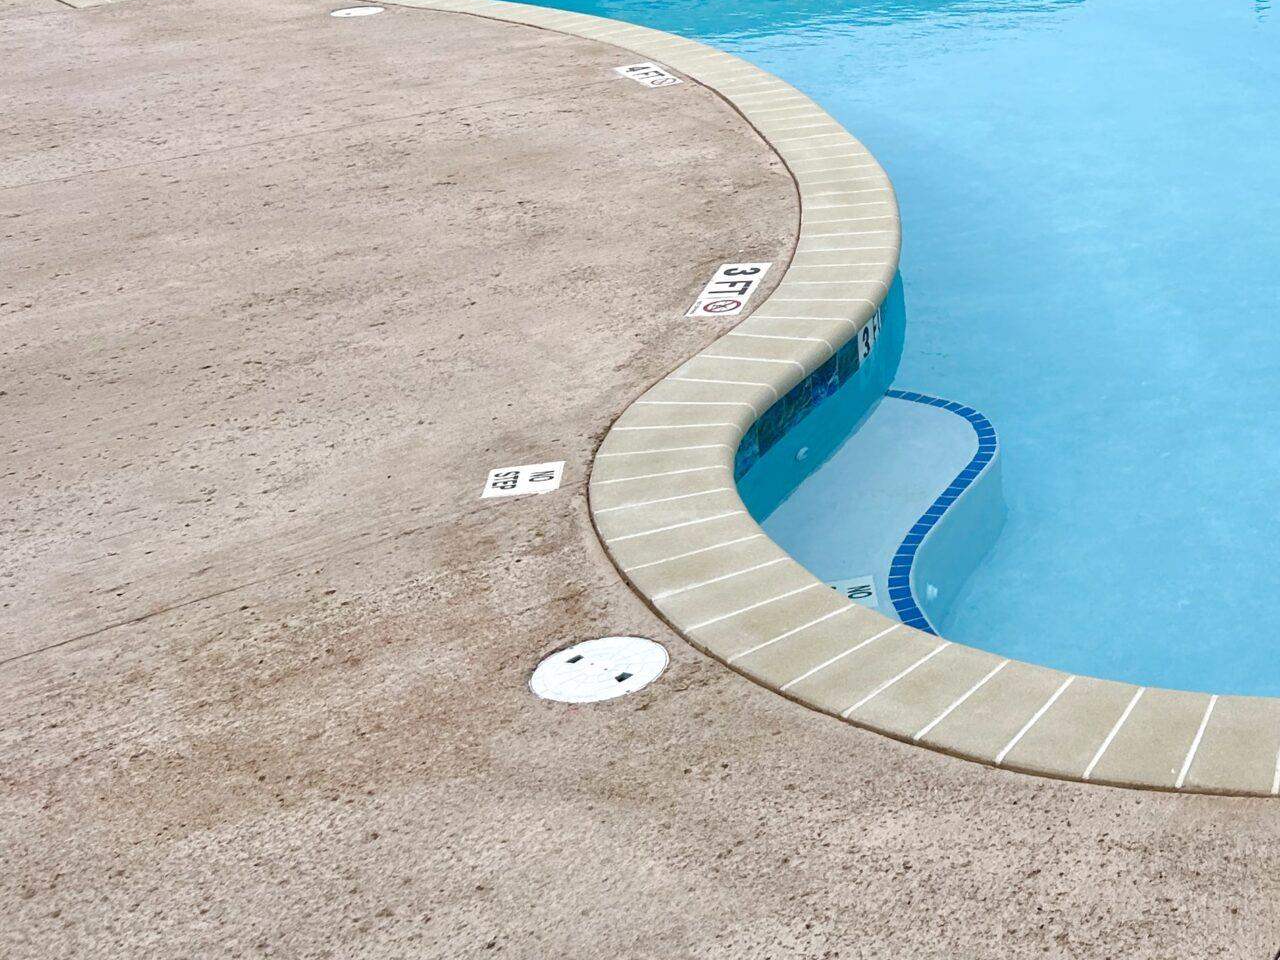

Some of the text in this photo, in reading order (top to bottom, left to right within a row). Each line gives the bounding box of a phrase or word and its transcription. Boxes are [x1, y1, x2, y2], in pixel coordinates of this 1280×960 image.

[632, 70, 666, 80] FT
[707, 267, 761, 296] 3 FT
[862, 326, 871, 358] 3
[491, 470, 521, 490] STEP
[528, 470, 555, 482] NO
[847, 584, 873, 599] NO
